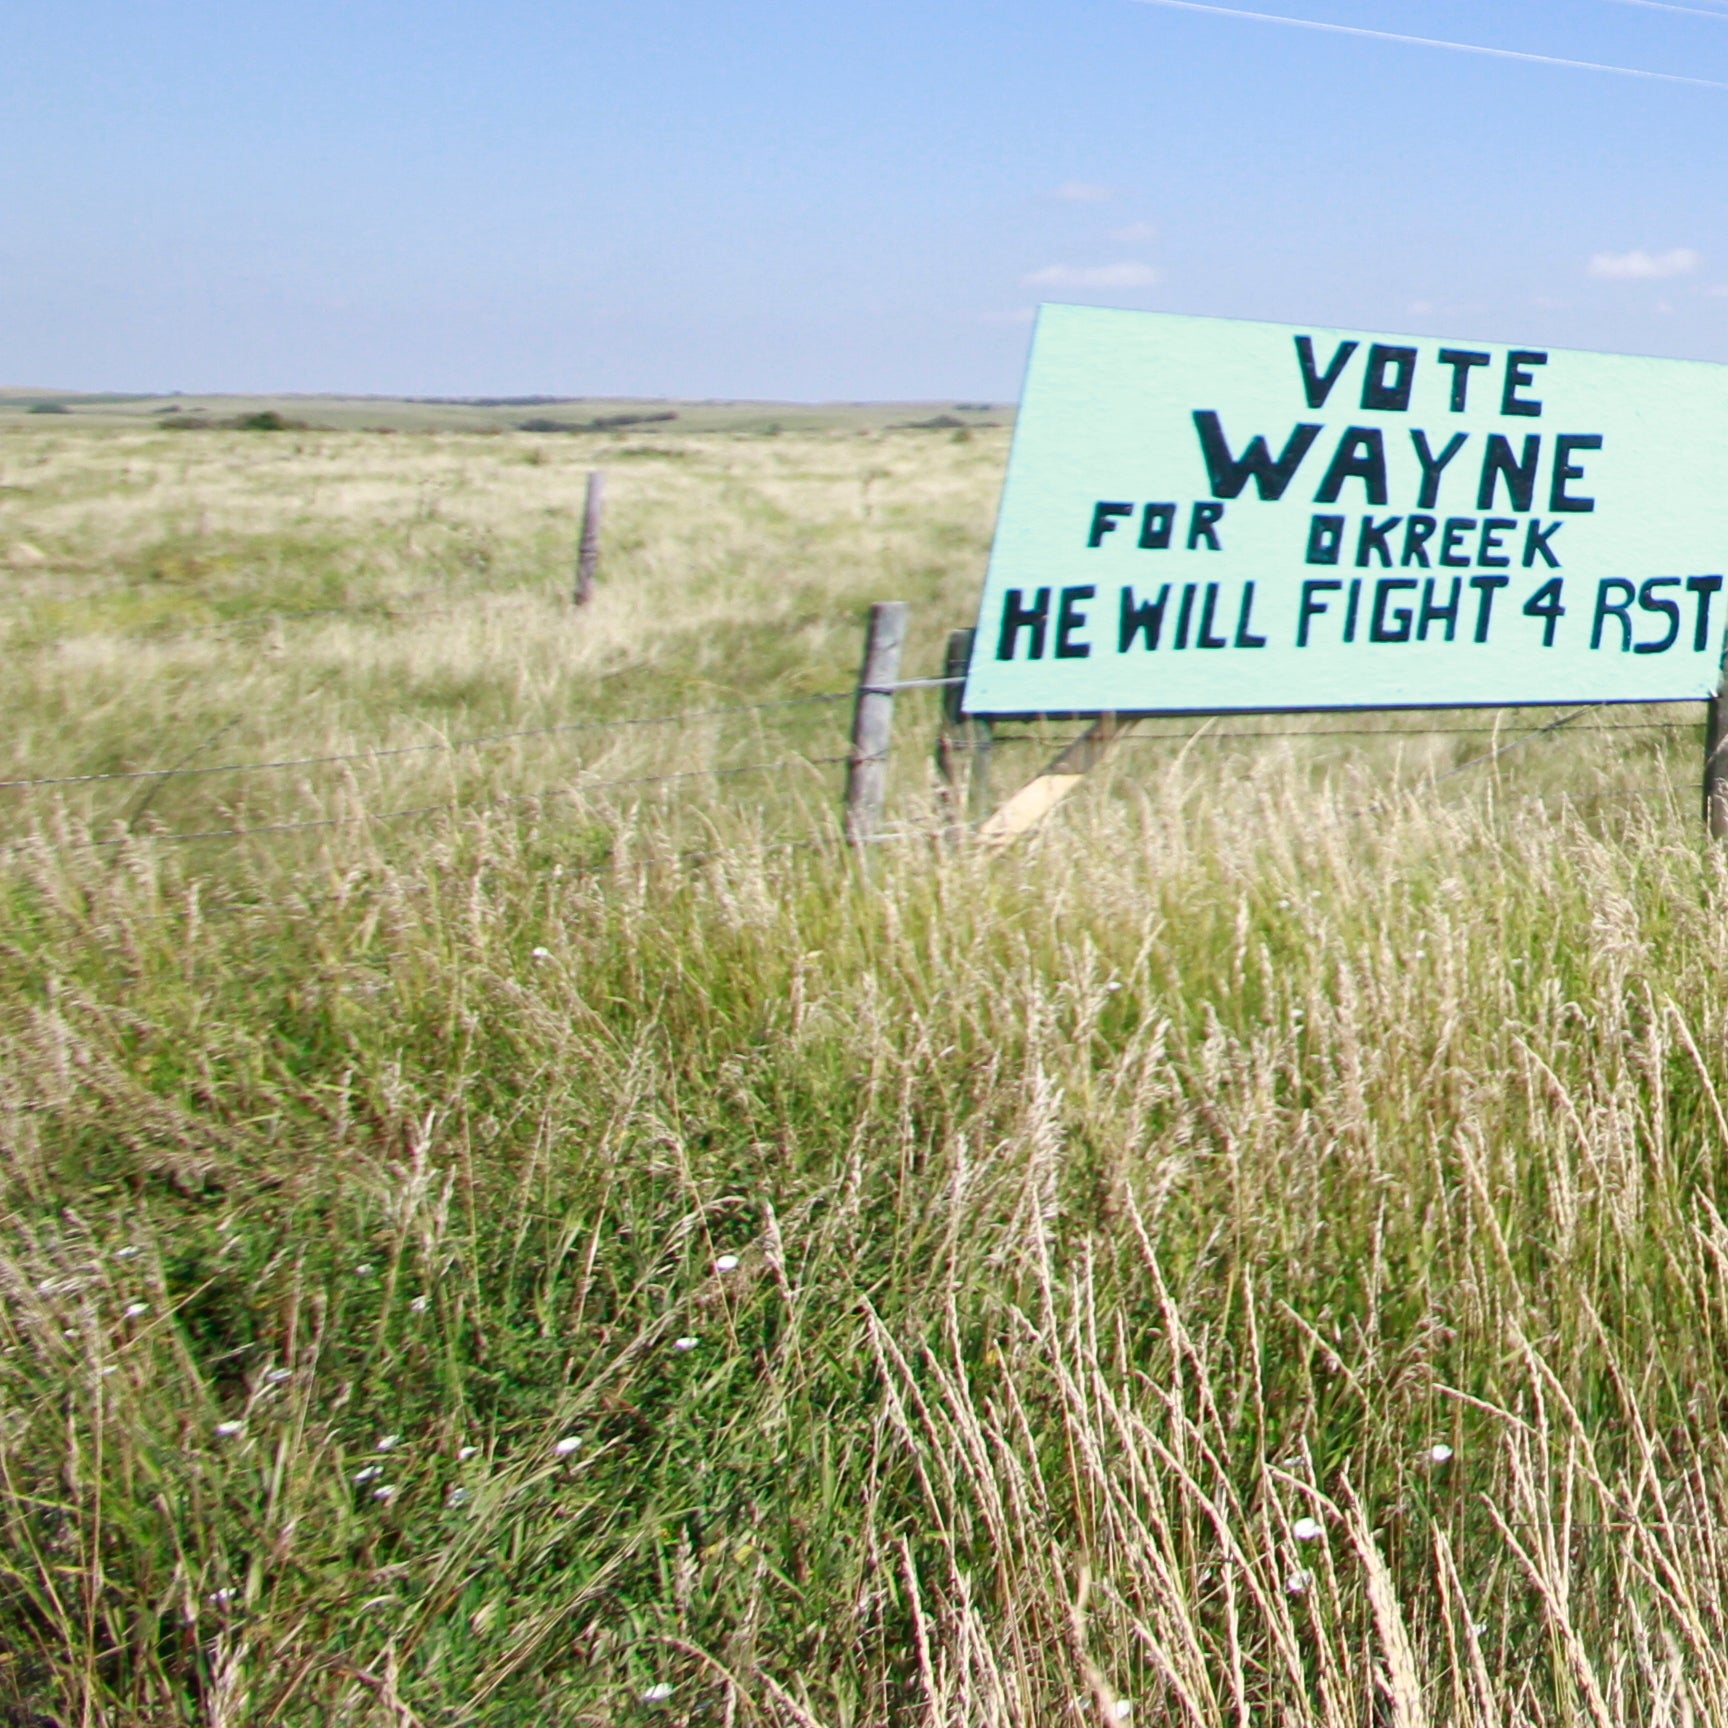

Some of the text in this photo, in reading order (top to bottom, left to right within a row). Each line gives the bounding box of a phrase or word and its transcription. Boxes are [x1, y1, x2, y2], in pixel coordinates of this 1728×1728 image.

[1294, 335, 1548, 418] VOTE
[1192, 410, 1603, 513] WAYNE
[1087, 501, 1563, 569] FOR OKREEK
[995, 574, 1724, 662] HE WILL FIGHT 4 RST
